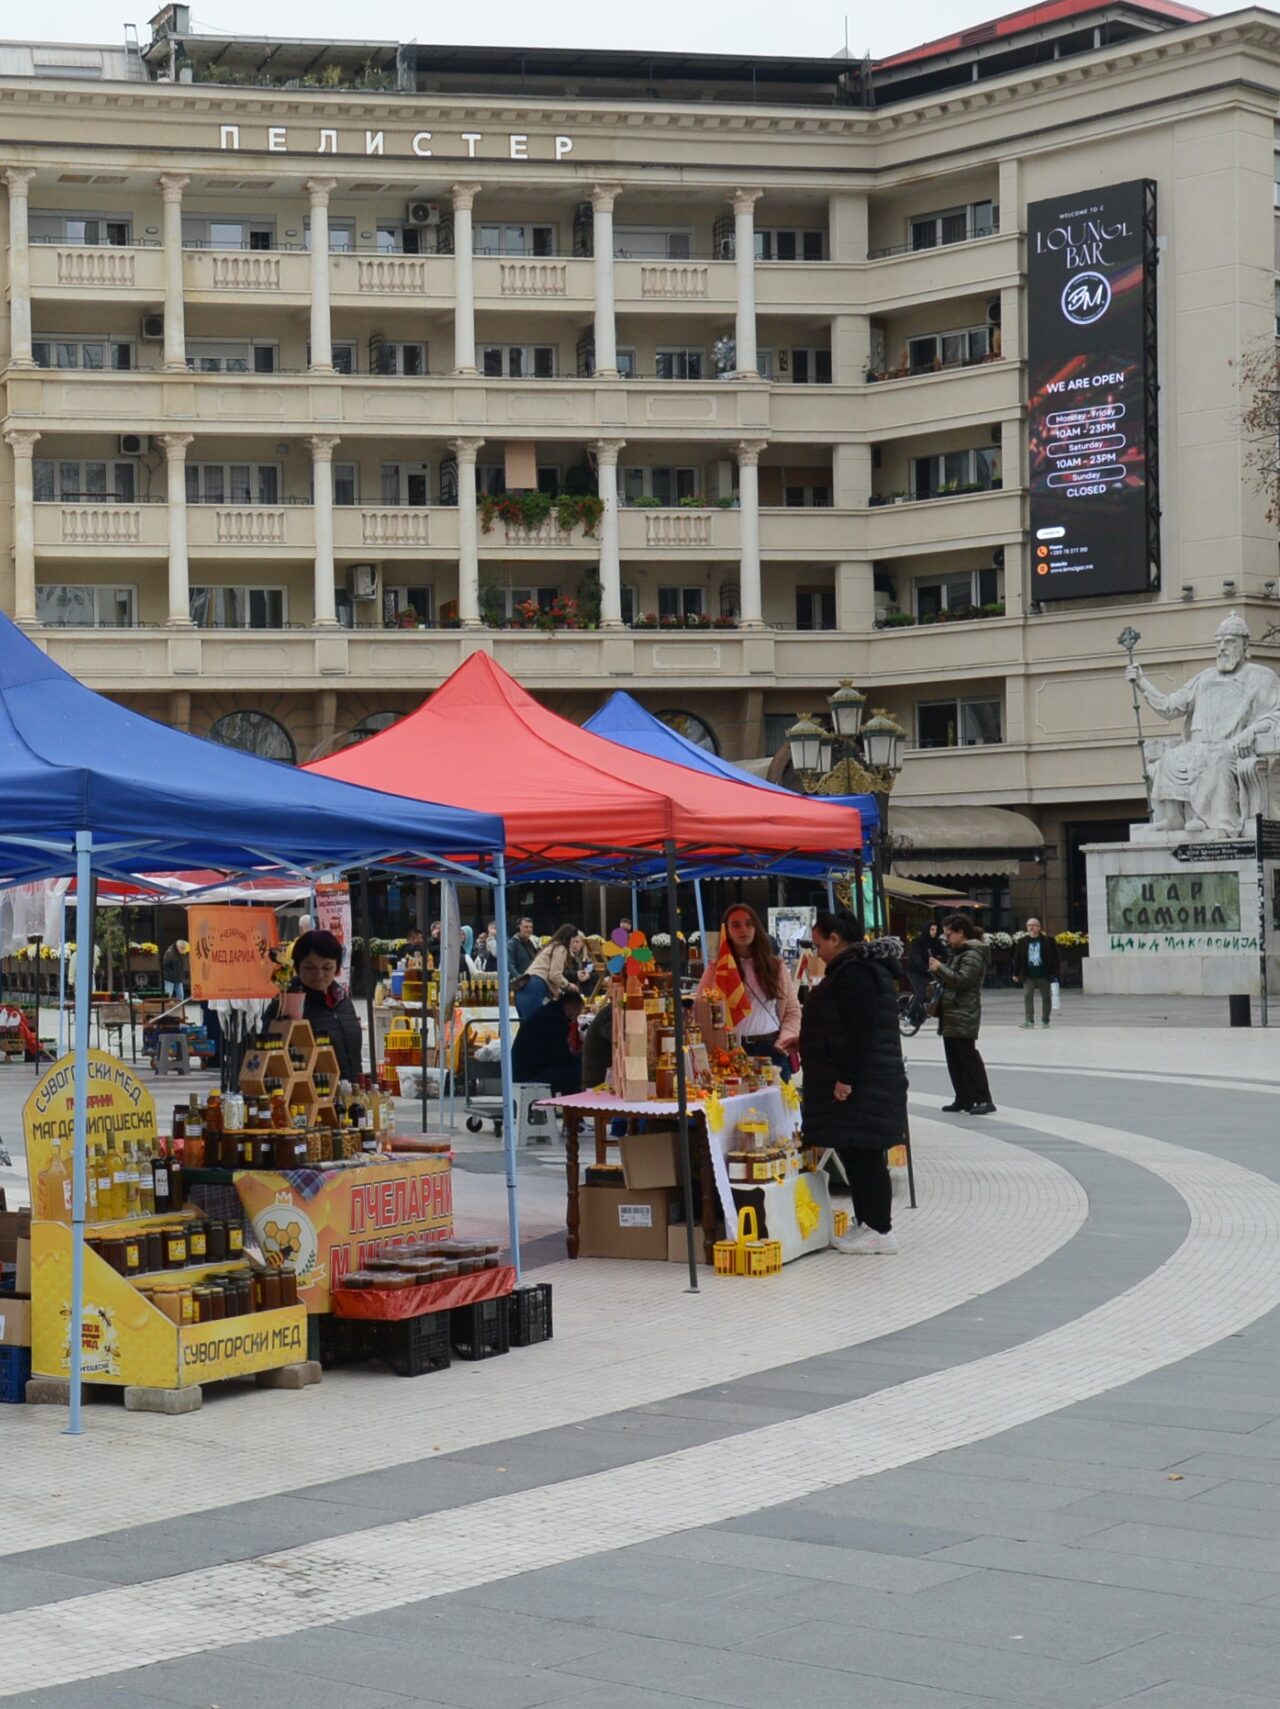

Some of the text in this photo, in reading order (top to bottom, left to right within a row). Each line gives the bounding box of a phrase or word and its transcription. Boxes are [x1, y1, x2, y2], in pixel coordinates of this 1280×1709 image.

[220, 125, 573, 160] ПЕЛИСТЕР
[1059, 208, 1088, 219] WELCOME
[1066, 241, 1115, 269] BAR
[1046, 372, 1125, 394] WE ARE OPEN
[1056, 412, 1086, 424] Monday
[1091, 408, 1115, 420] Friday
[1056, 427, 1081, 439] 10AM
[1089, 422, 1116, 435] 23PM
[1069, 440, 1104, 452] Saturday
[1056, 458, 1081, 469] 10AM
[1089, 453, 1116, 465] 23PM
[1072, 471, 1101, 482] Sunday
[1066, 484, 1107, 497] CLOSED
[1141, 882, 1203, 903] ЦАР
[1122, 905, 1227, 927] САМОИЛ
[35, 1062, 141, 1113] СУВОГСКИ МЕД
[86, 1110, 153, 1135] ИЛОШЕСКА
[184, 1324, 301, 1366] СУВОГОРСКИ МЕД
